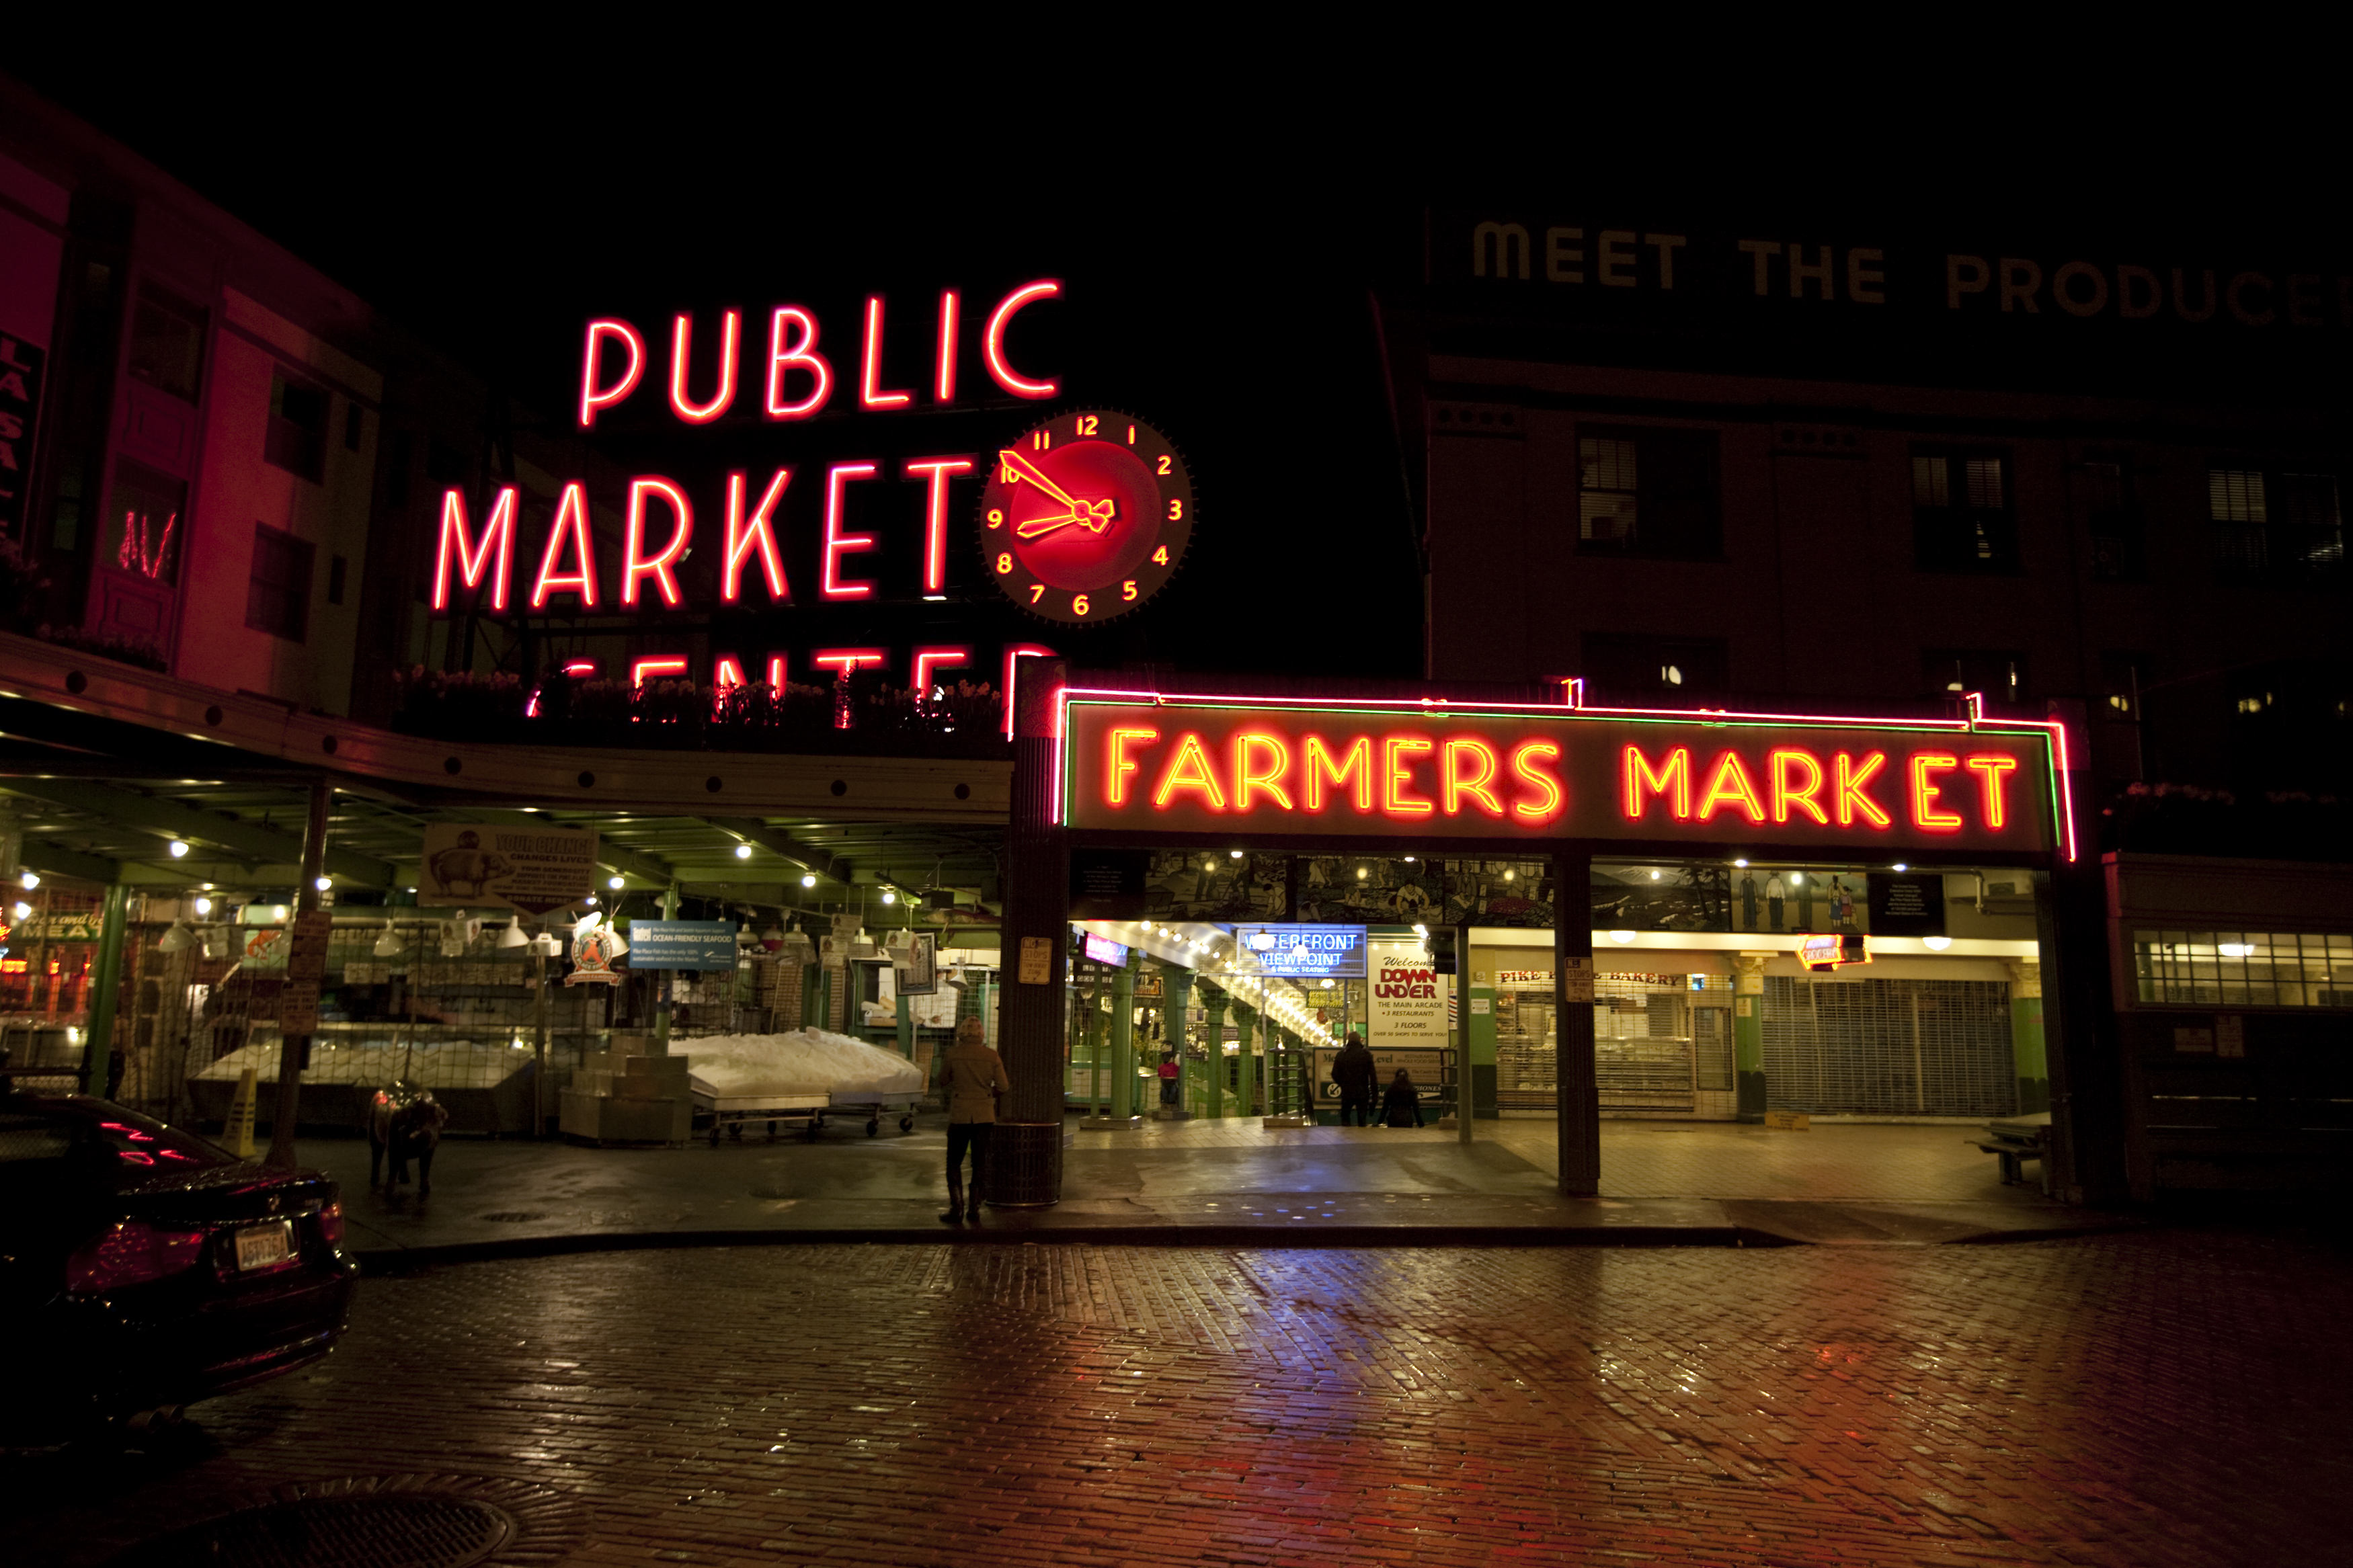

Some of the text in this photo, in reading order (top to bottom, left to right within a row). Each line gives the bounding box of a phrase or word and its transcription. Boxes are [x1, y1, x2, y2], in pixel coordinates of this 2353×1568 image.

[1473, 220, 1686, 290] MEET
[1738, 239, 1884, 304] THE
[580, 280, 1059, 426] PUBLIC
[1077, 415, 1099, 436] 12
[1128, 425, 1135, 444] 1
[1034, 431, 1049, 450] 11
[1157, 455, 1171, 474] 2
[1000, 466, 1021, 483] 10
[988, 509, 1002, 528] 9
[1168, 499, 1182, 520] 3
[434, 459, 972, 609] MARKET
[997, 553, 1012, 574] 8
[1152, 545, 1169, 565] 4
[1030, 584, 1045, 604] 7
[1123, 580, 1138, 600] 5
[1073, 595, 1089, 615] 6
[1110, 730, 2016, 827] FARMERS MARKET
[495, 834, 594, 855] YOUR CHANGE
[510, 853, 592, 864] CHANGES LIVES!
[507, 895, 543, 903] DONATE
[652, 934, 732, 943] OCEAN-FRIENDLY SEAFOOD
[1244, 934, 1357, 950] WTERFRONT
[1024, 950, 1047, 959] STOPS
[1259, 952, 1343, 965] VIEWPOINT
[1383, 956, 1435, 966] Welcom
[1380, 969, 1437, 986] DOWN
[1501, 971, 1541, 983] PIKE
[1610, 973, 1680, 986] BAKERY
[1568, 970, 1591, 978] STOPS
[1375, 984, 1437, 999] UNDER
